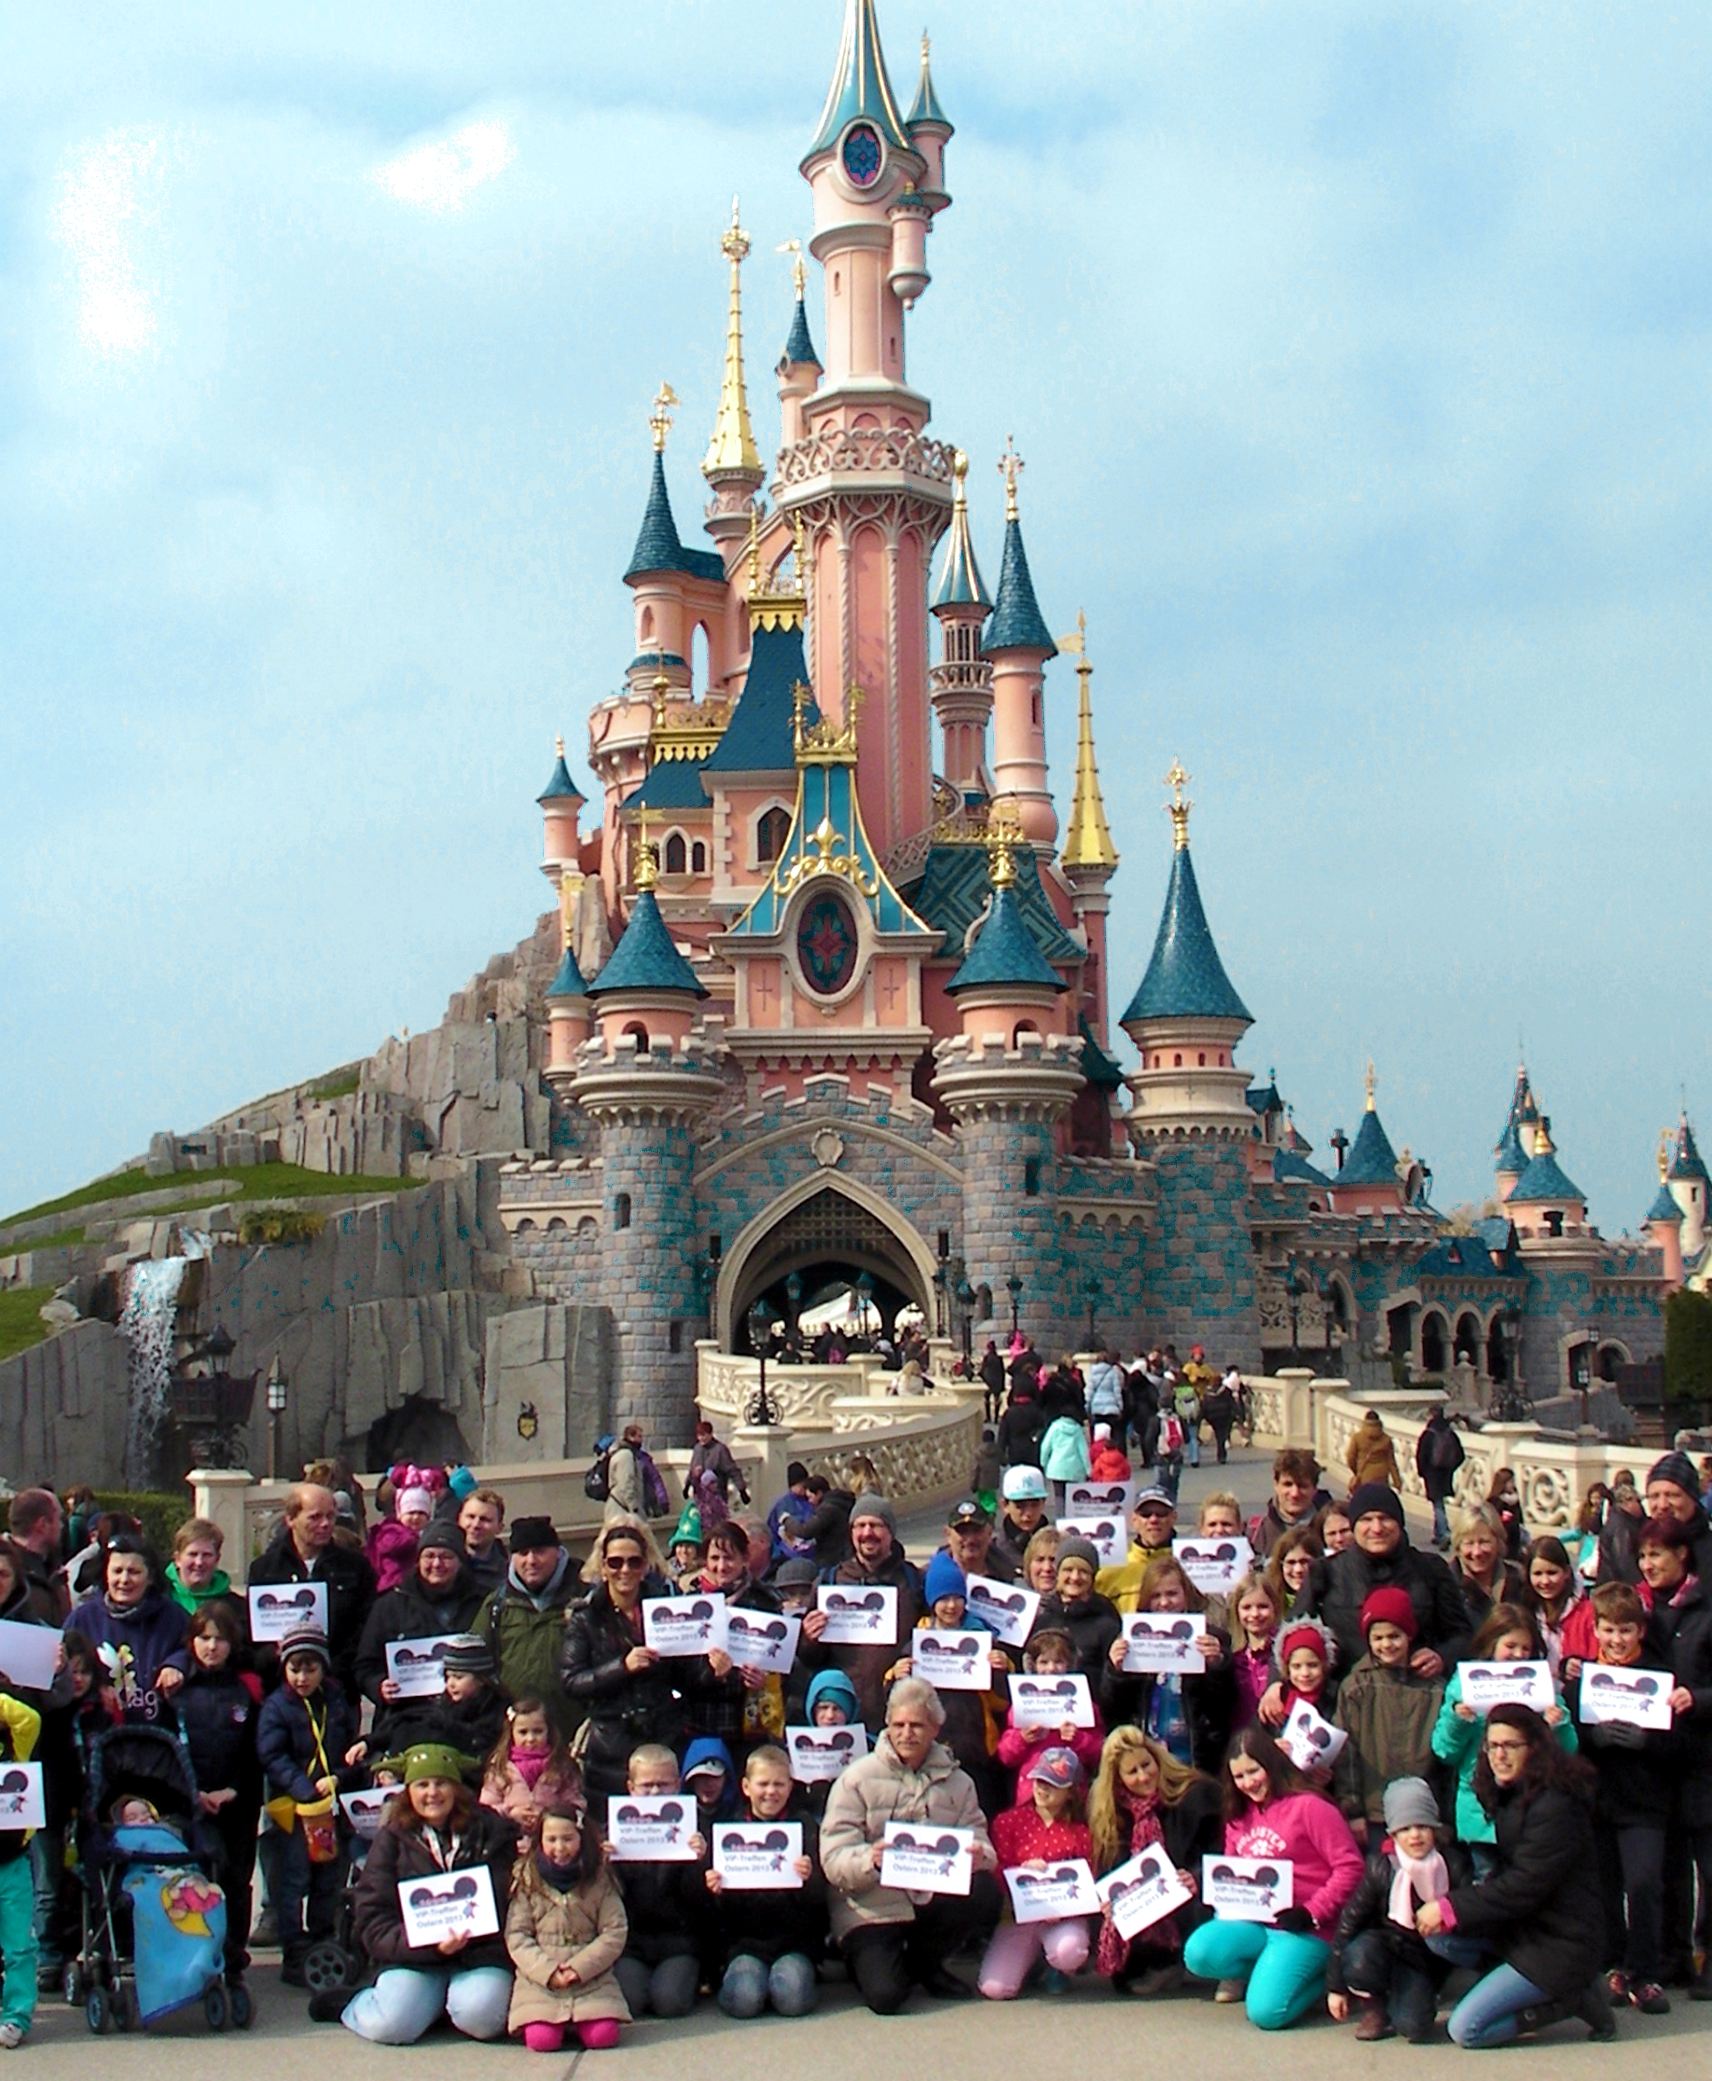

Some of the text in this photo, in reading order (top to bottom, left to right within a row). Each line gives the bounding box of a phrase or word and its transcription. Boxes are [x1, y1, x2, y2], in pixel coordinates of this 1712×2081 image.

[922, 1656, 959, 1664] VIP-Treffen
[620, 1826, 661, 1834] VIP-Treffen
[620, 1836, 644, 1844] Ostern
[724, 1854, 767, 1862] VIP-Treffen
[894, 1854, 936, 1864] VIP-Treffen
[724, 1864, 750, 1872] Ostern
[892, 1864, 938, 1876] Ostern 2013
[1214, 1886, 1256, 1896] VIP-Treffen
[1214, 1895, 1260, 1906] Ostern 2013
[416, 1905, 458, 1918] VIP-Treffen
[416, 1914, 463, 1928] Ostern 2013
